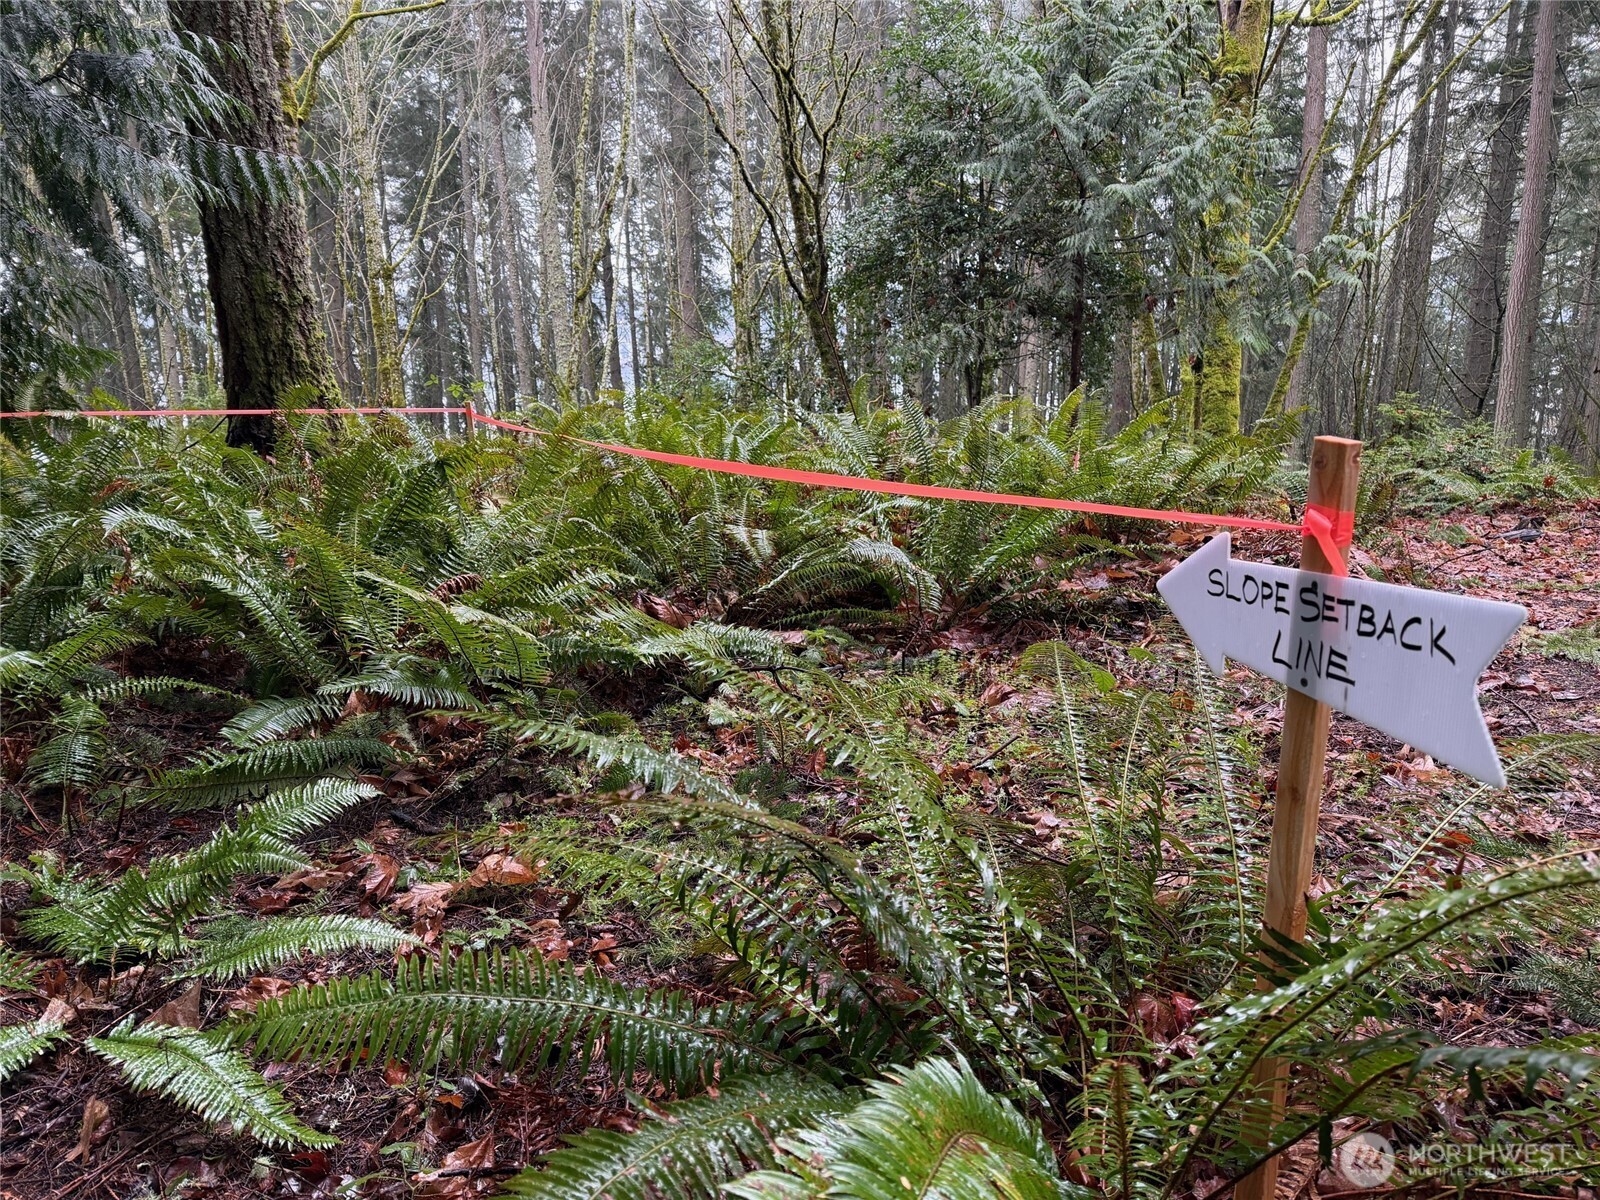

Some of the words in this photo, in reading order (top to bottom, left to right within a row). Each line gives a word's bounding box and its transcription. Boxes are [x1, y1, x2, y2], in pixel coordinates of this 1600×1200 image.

[1207, 568, 1290, 615] SLOPE
[1300, 585, 1456, 666] SETBACK
[1272, 630, 1355, 687] LINE
